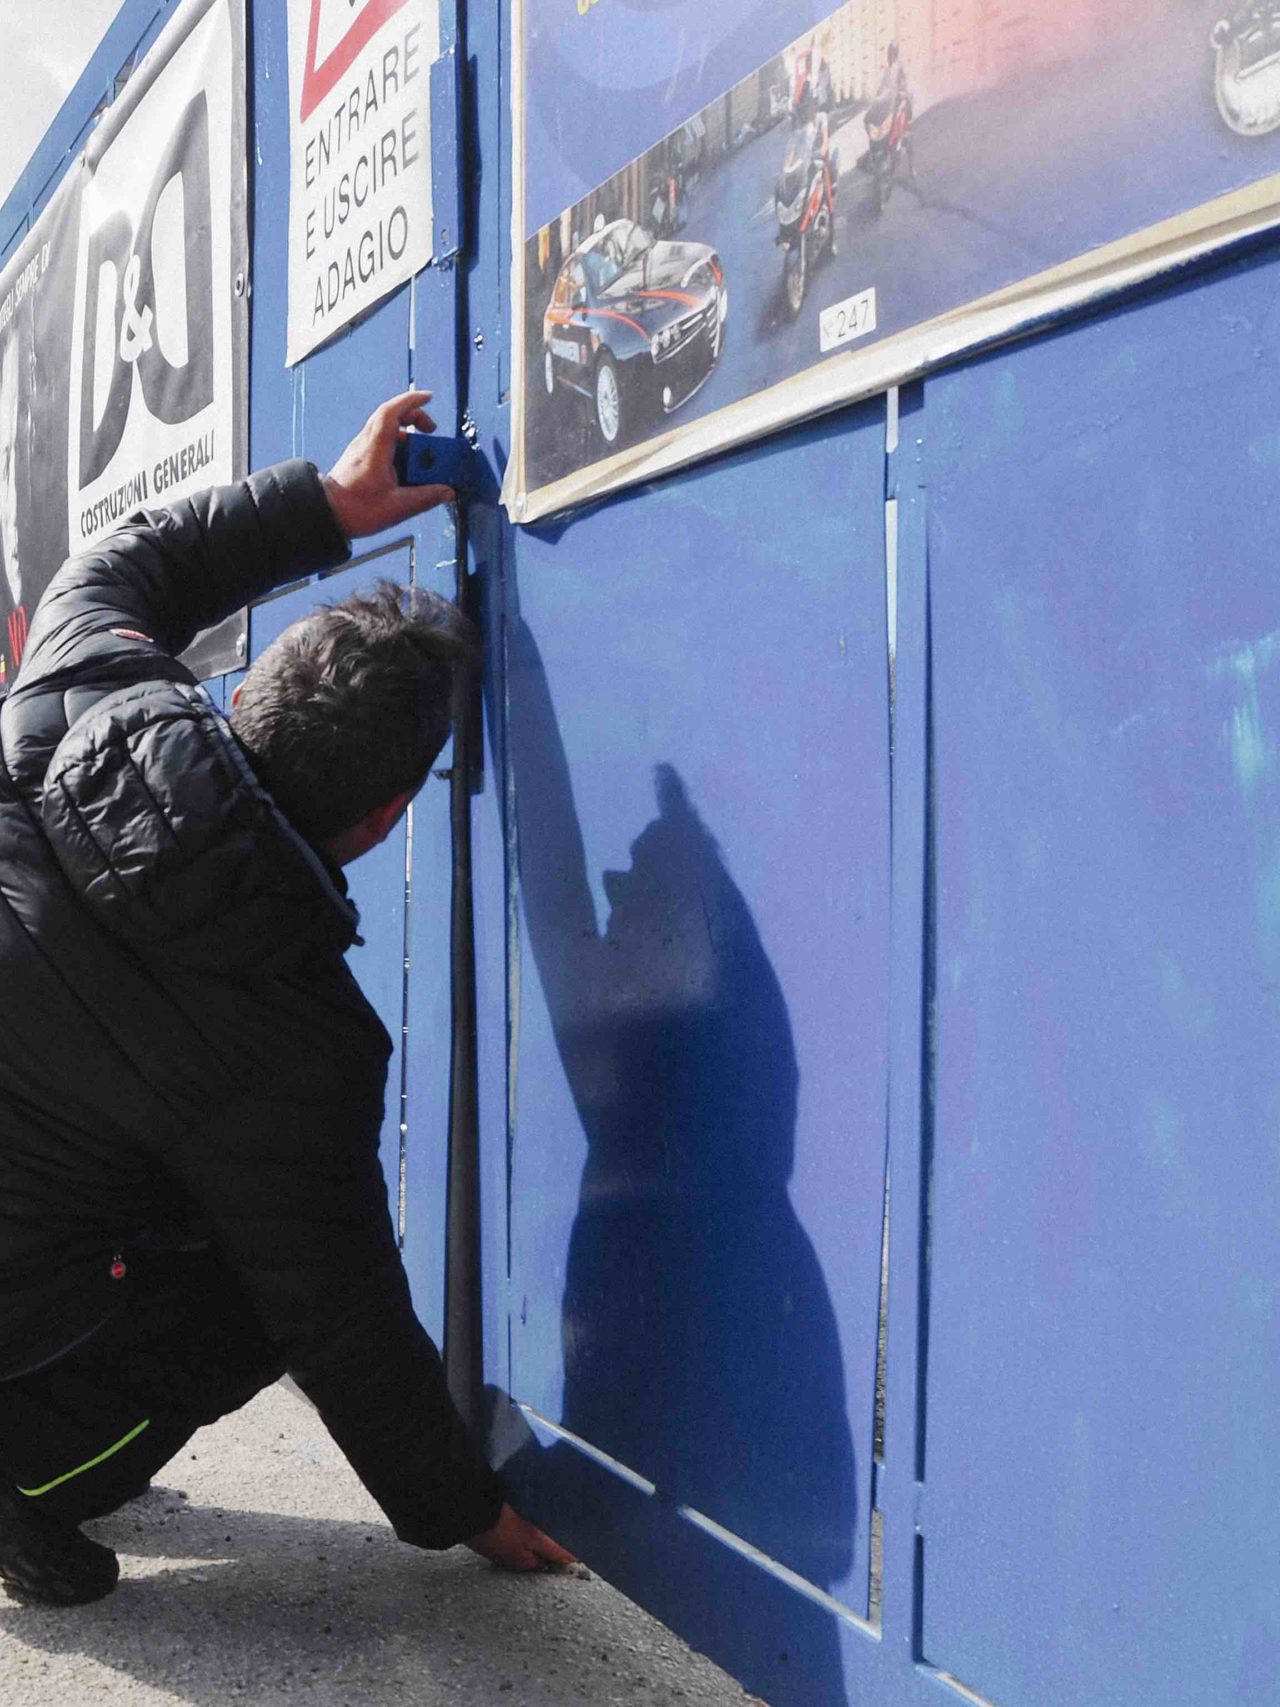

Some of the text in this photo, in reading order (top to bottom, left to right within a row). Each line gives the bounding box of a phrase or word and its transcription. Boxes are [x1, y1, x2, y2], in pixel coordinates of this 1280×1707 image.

[305, 23, 420, 189] ENTRARE
[306, 107, 419, 260] E USCIRE
[312, 205, 408, 326] ADAGIO
[837, 299, 869, 338] 247
[80, 428, 215, 538] COSTRUZIONI GENERALI
